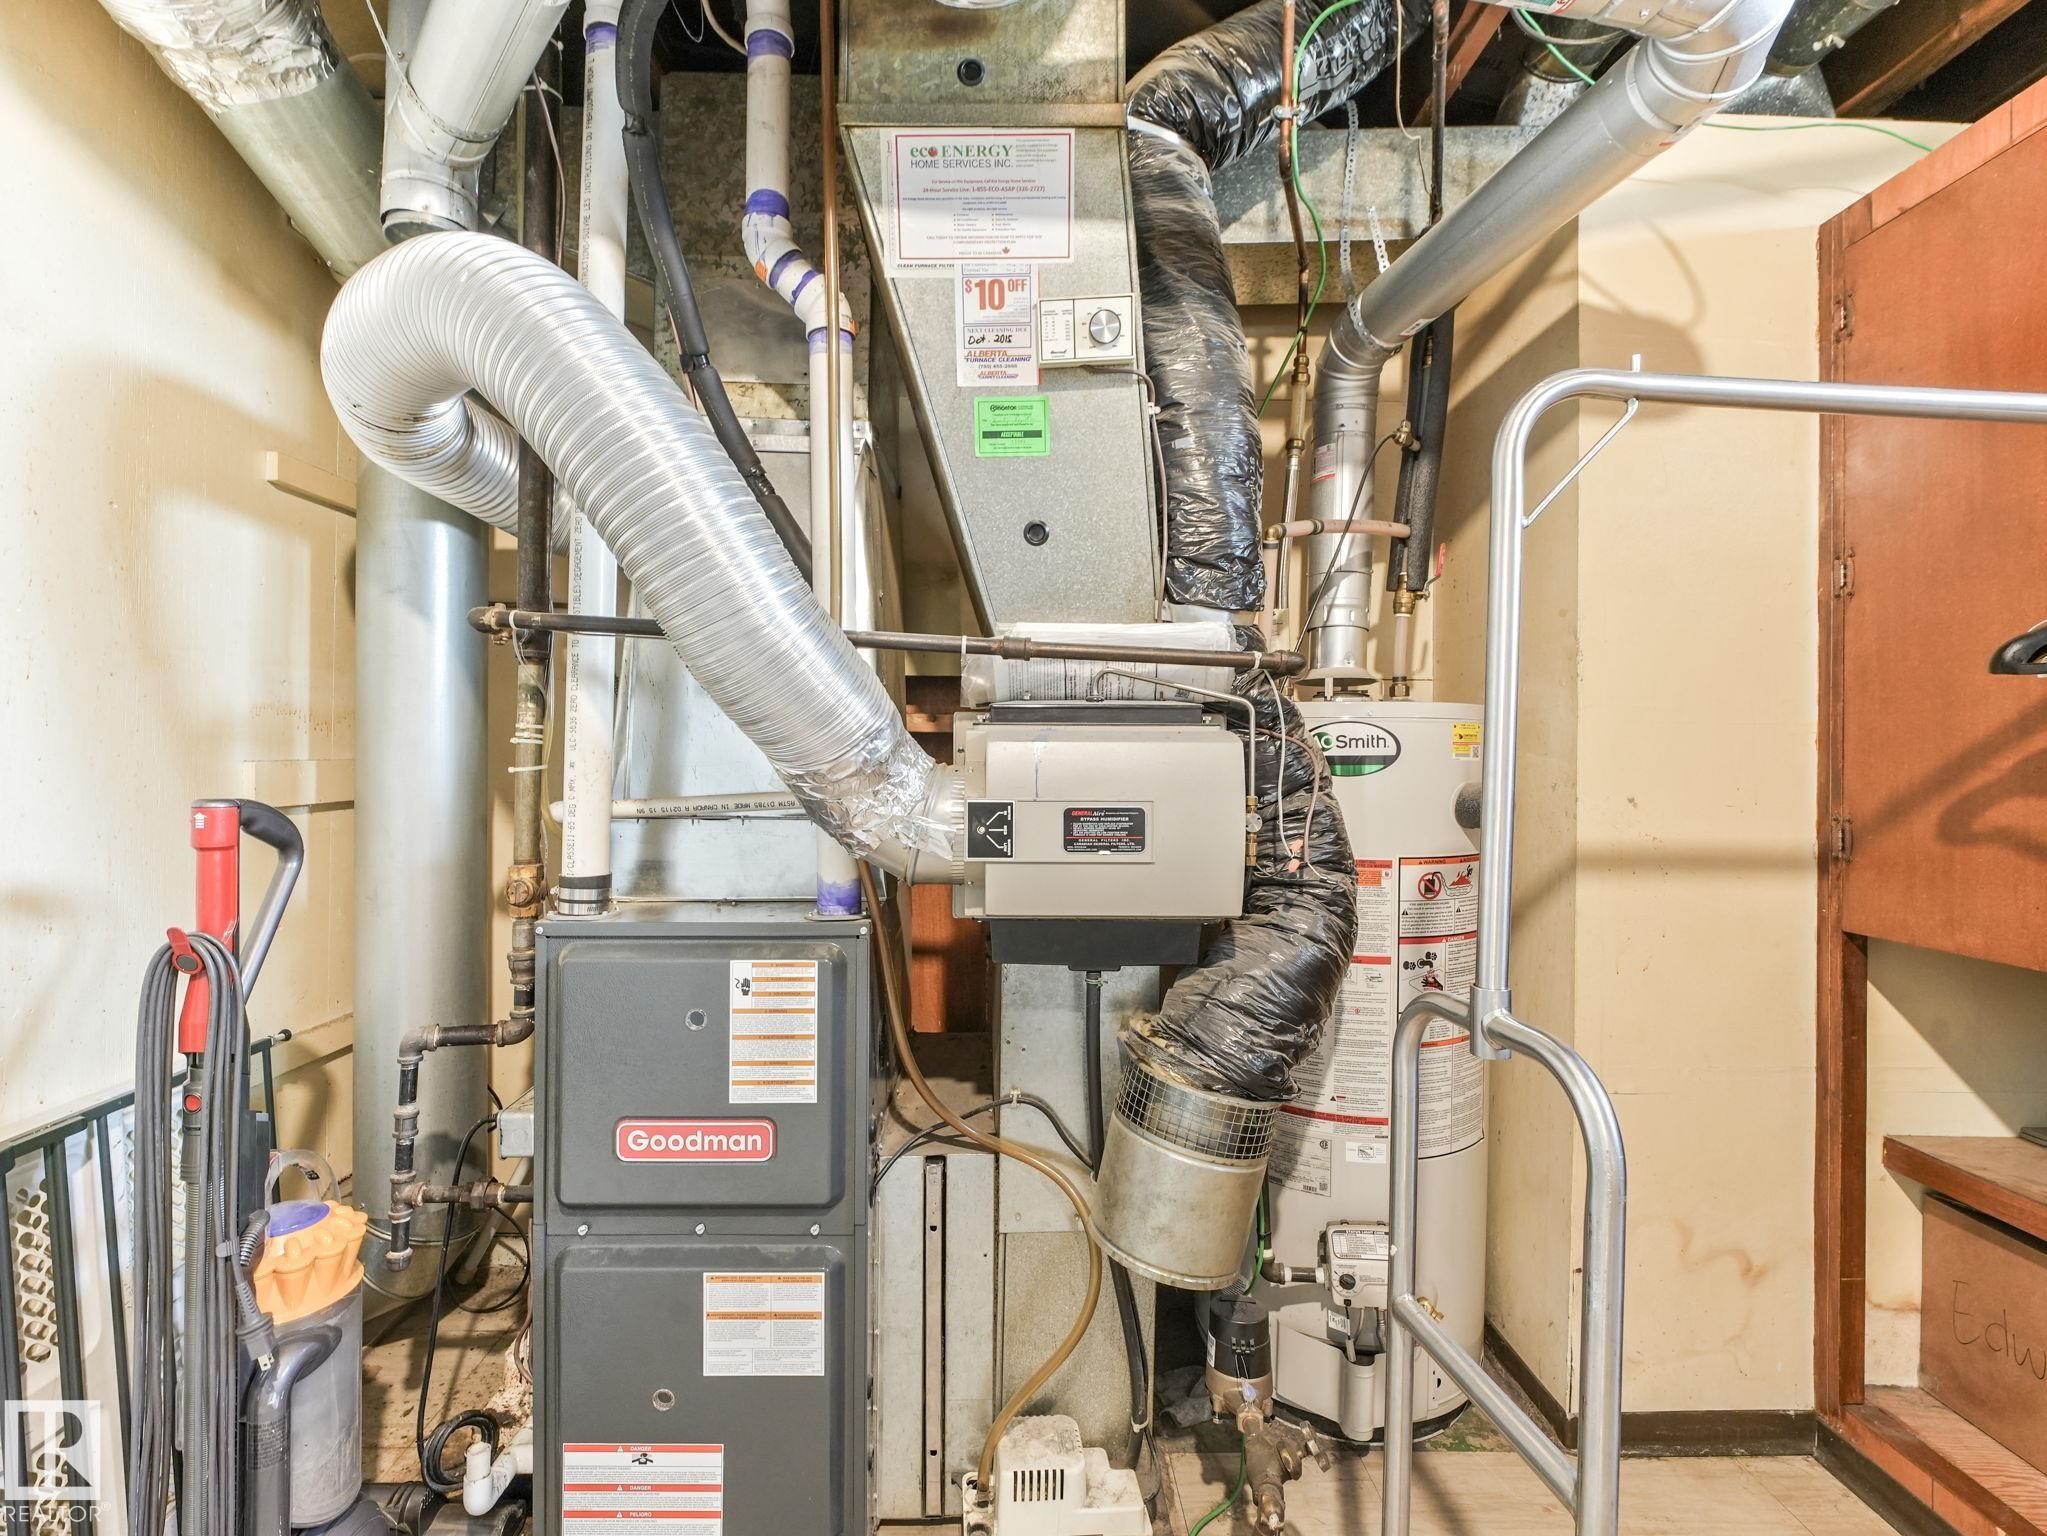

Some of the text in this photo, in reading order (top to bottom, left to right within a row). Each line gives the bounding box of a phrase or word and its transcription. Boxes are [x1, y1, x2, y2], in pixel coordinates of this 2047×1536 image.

[942, 145, 1013, 158] ENERGY
[910, 159, 1014, 169] HOME SERVICES INC.
[1007, 279, 1028, 292] OFF
[571, 640, 579, 648] TO
[570, 653, 579, 691] CLEARANCE
[1336, 734, 1387, 749] Smith
[627, 1130, 762, 1152] Goodman
